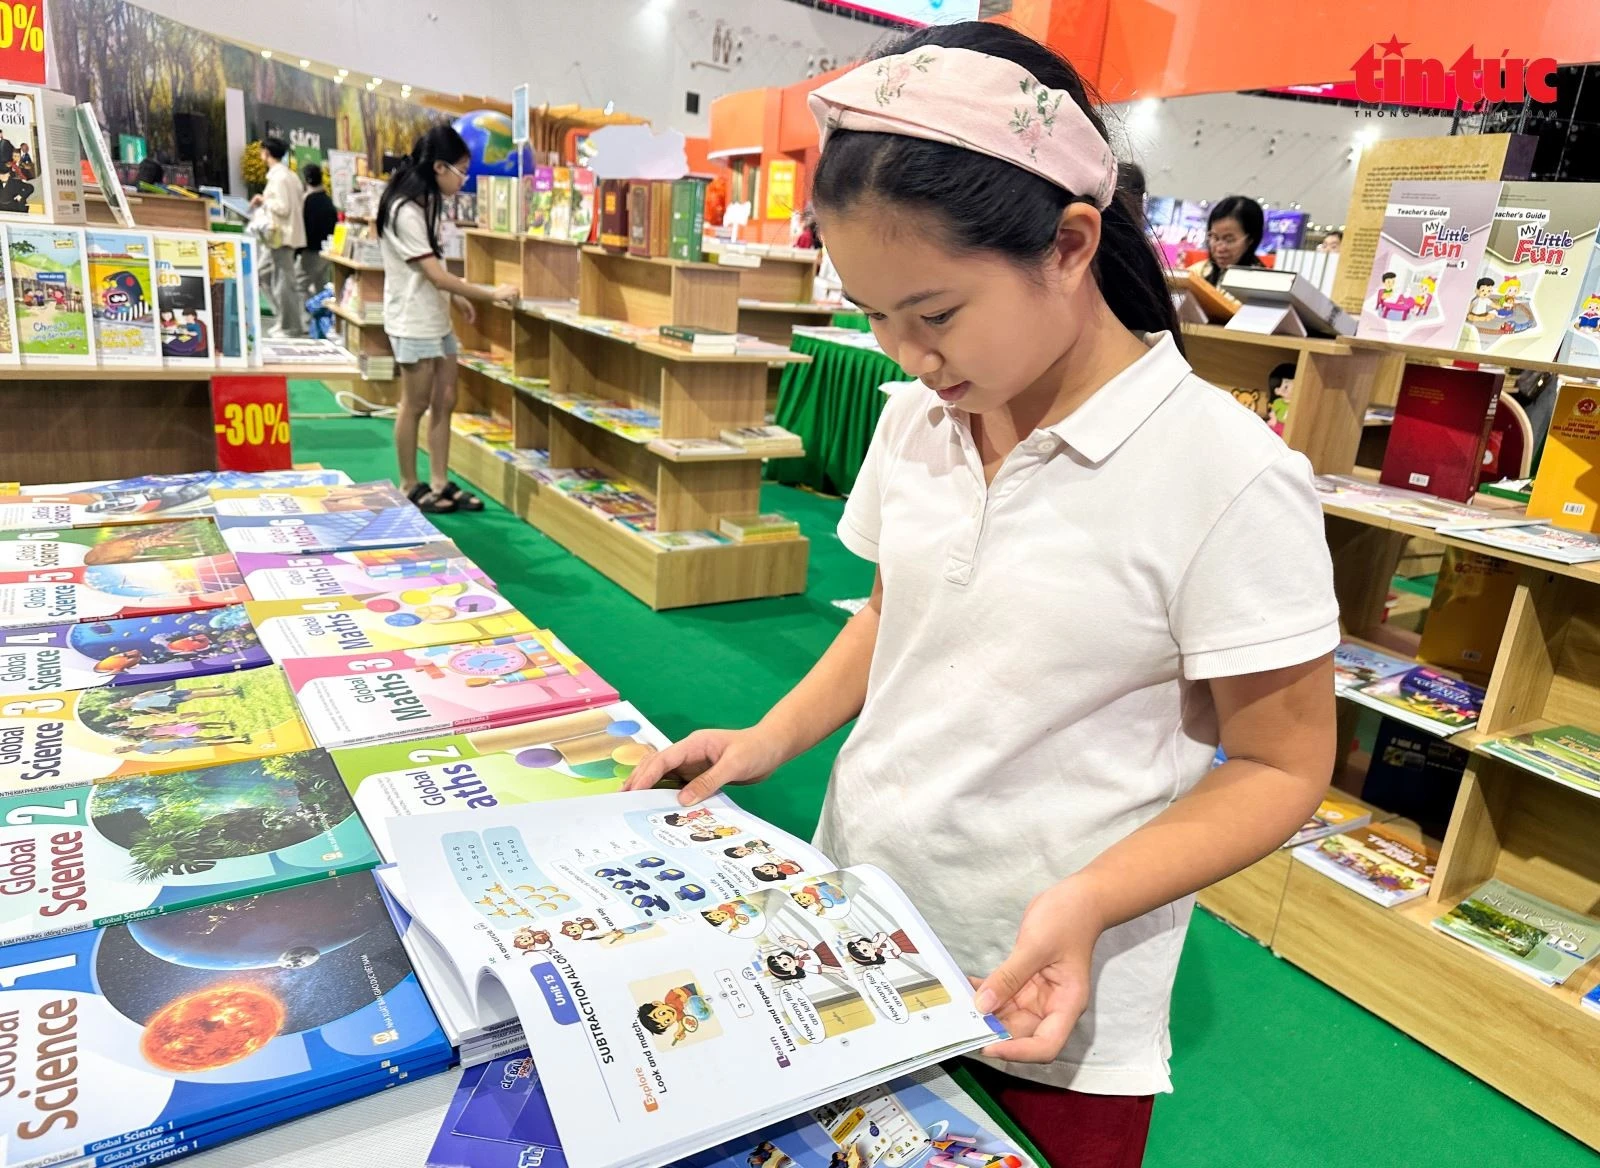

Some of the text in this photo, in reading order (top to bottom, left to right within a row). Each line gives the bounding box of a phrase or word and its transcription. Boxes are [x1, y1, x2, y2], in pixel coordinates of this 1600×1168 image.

[1429, 209, 1448, 217] Guide
[1525, 211, 1547, 220] Guide
[1424, 221, 1440, 233] My
[1437, 225, 1470, 242] Little
[1520, 225, 1538, 238] My
[1535, 229, 1573, 247] Little
[1419, 235, 1463, 258] Fun
[1513, 239, 1564, 265] Fun
[1560, 268, 1569, 276] 2
[214, 403, 291, 446] -30%
[33, 543, 60, 568] Science
[286, 558, 324, 567] 5
[28, 571, 75, 582] 5
[306, 568, 347, 595] Maths
[23, 587, 46, 609] Global
[48, 585, 77, 617] Science
[302, 602, 341, 611] 4
[5, 632, 57, 644] 4
[298, 616, 325, 636] Global
[325, 613, 374, 650] Maths
[0, 653, 27, 682] Global
[28, 650, 62, 691] Science
[347, 658, 395, 672] 3
[344, 677, 376, 704] Global
[375, 673, 432, 721] Maths
[2, 698, 65, 716] 3
[0, 726, 25, 765] Global
[20, 722, 64, 780] Science
[408, 745, 462, 763] 2
[405, 771, 446, 806] Global
[441, 764, 498, 809] aths
[5, 799, 79, 825] 2
[0, 838, 36, 896] Global
[38, 830, 88, 917] Science
[98, 914, 122, 926] Global
[124, 908, 156, 920] Science
[1547, 934, 1579, 952] 10
[0, 954, 76, 988] 1
[543, 974, 566, 1007] Unit 13
[866, 972, 902, 1021] How many fish
[892, 996, 902, 1007] are
[553, 954, 614, 1065] SUBTRACTION ALL OR
[754, 982, 796, 1052] Listen and repeat.
[782, 988, 816, 1041] How many fish
[809, 1013, 819, 1026] are
[631, 1018, 668, 1094] Look and match.
[770, 1036, 789, 1063] Learn
[17, 998, 79, 1140] Science
[635, 1066, 657, 1105] Explore
[91, 1120, 174, 1152] Global Science 1
[103, 1131, 185, 1164] Global Science 1
[149, 1140, 199, 1162] Science 1
